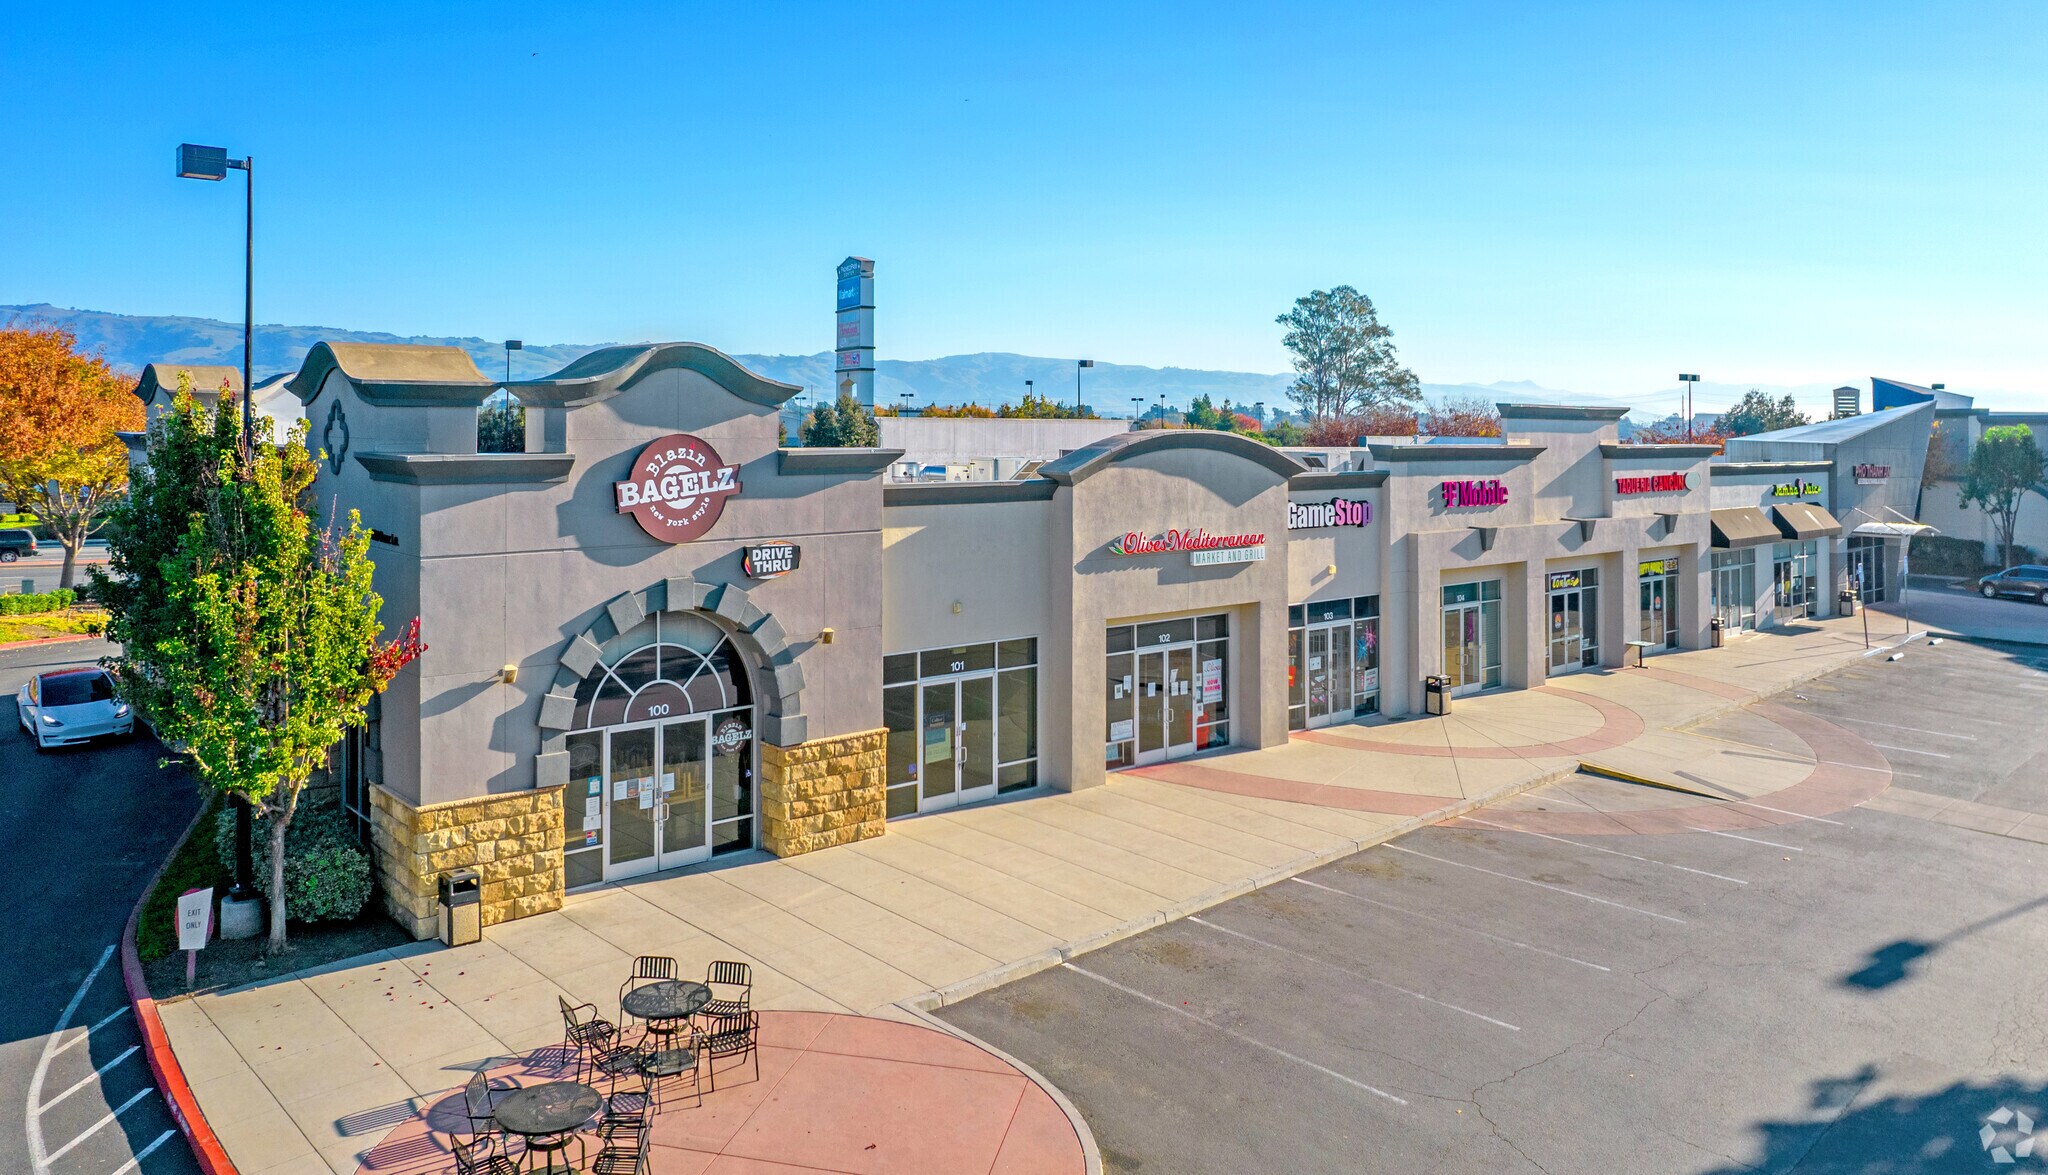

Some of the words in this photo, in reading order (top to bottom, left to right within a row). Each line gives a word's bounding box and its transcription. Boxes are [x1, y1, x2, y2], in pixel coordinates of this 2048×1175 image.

[646, 447, 706, 477] Blazin
[618, 467, 735, 507] BAGELZ
[1617, 477, 1651, 494] TAQUERIA
[1773, 484, 1799, 496] Jamba
[1804, 482, 1821, 495] Juice
[1459, 480, 1509, 506] Mobile
[650, 505, 664, 521] new
[666, 518, 690, 527] york
[692, 497, 710, 521] style
[1288, 499, 1373, 529] GameStop
[1124, 530, 1167, 555] Olives
[1167, 527, 1265, 551] Mediterranean
[752, 547, 793, 561] DRIVE
[1195, 550, 1225, 564] MARKET
[1227, 550, 1242, 561] AND
[1244, 548, 1264, 560] GRILL
[754, 559, 791, 573] THRU
[1324, 612, 1334, 620] 103
[1158, 633, 1171, 643] 102
[951, 660, 965, 671] 101
[648, 704, 670, 716] 100
[712, 730, 752, 745] BAGELZ
[188, 909, 201, 917] EXIT
[186, 921, 202, 930] ONLY
